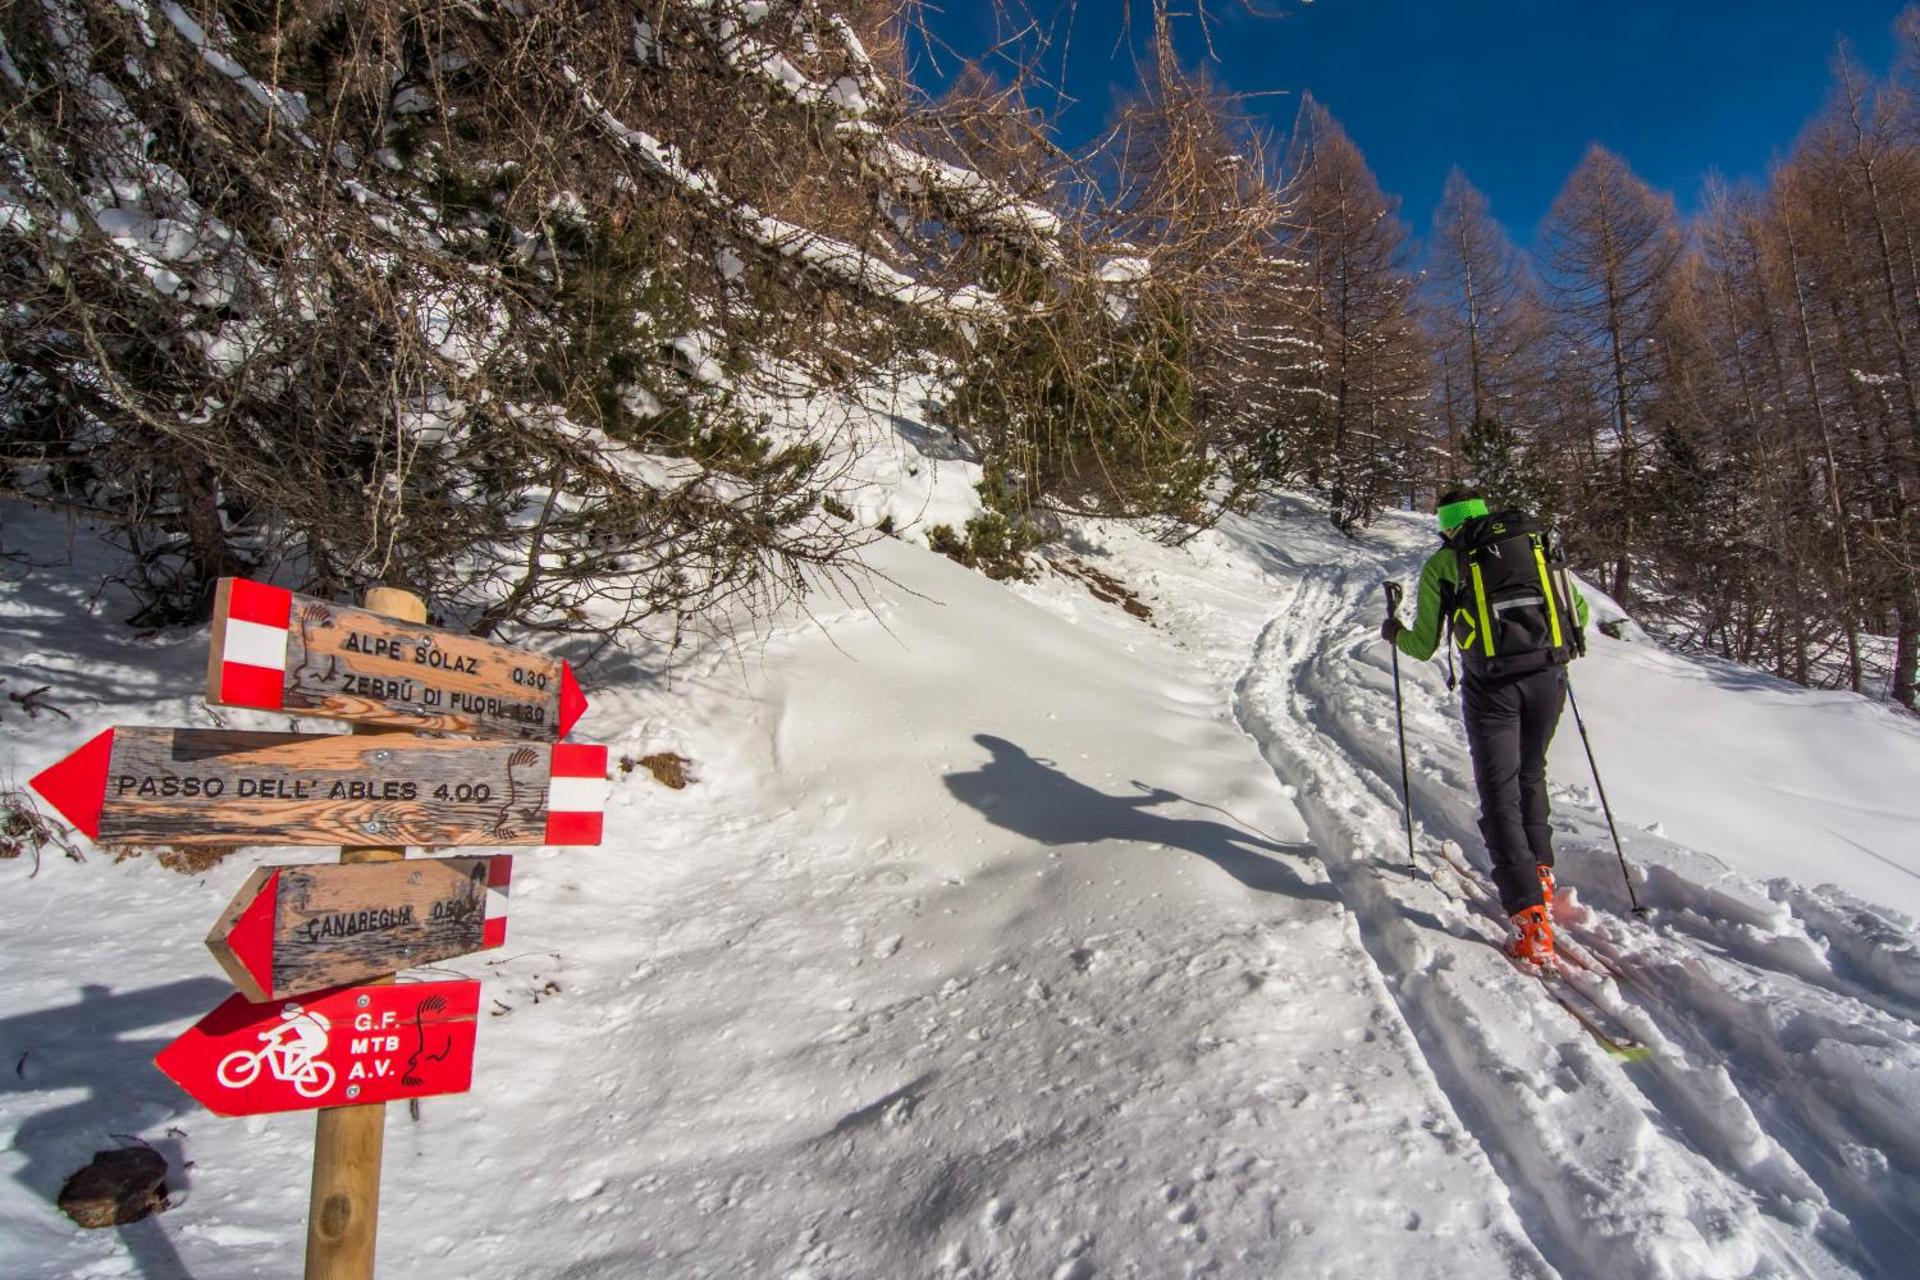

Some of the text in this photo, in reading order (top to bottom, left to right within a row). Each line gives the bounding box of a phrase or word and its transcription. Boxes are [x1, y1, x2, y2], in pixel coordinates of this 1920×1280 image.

[345, 632, 547, 691] ALPE SOLAZ 0.30
[424, 688, 442, 707] DI
[450, 693, 502, 719] FUORI
[118, 775, 491, 803] PASSO DELL' ABLES 4.00
[354, 1011, 400, 1031] G.F.
[350, 1035, 400, 1054] MTB
[348, 1058, 395, 1080] A.V.
